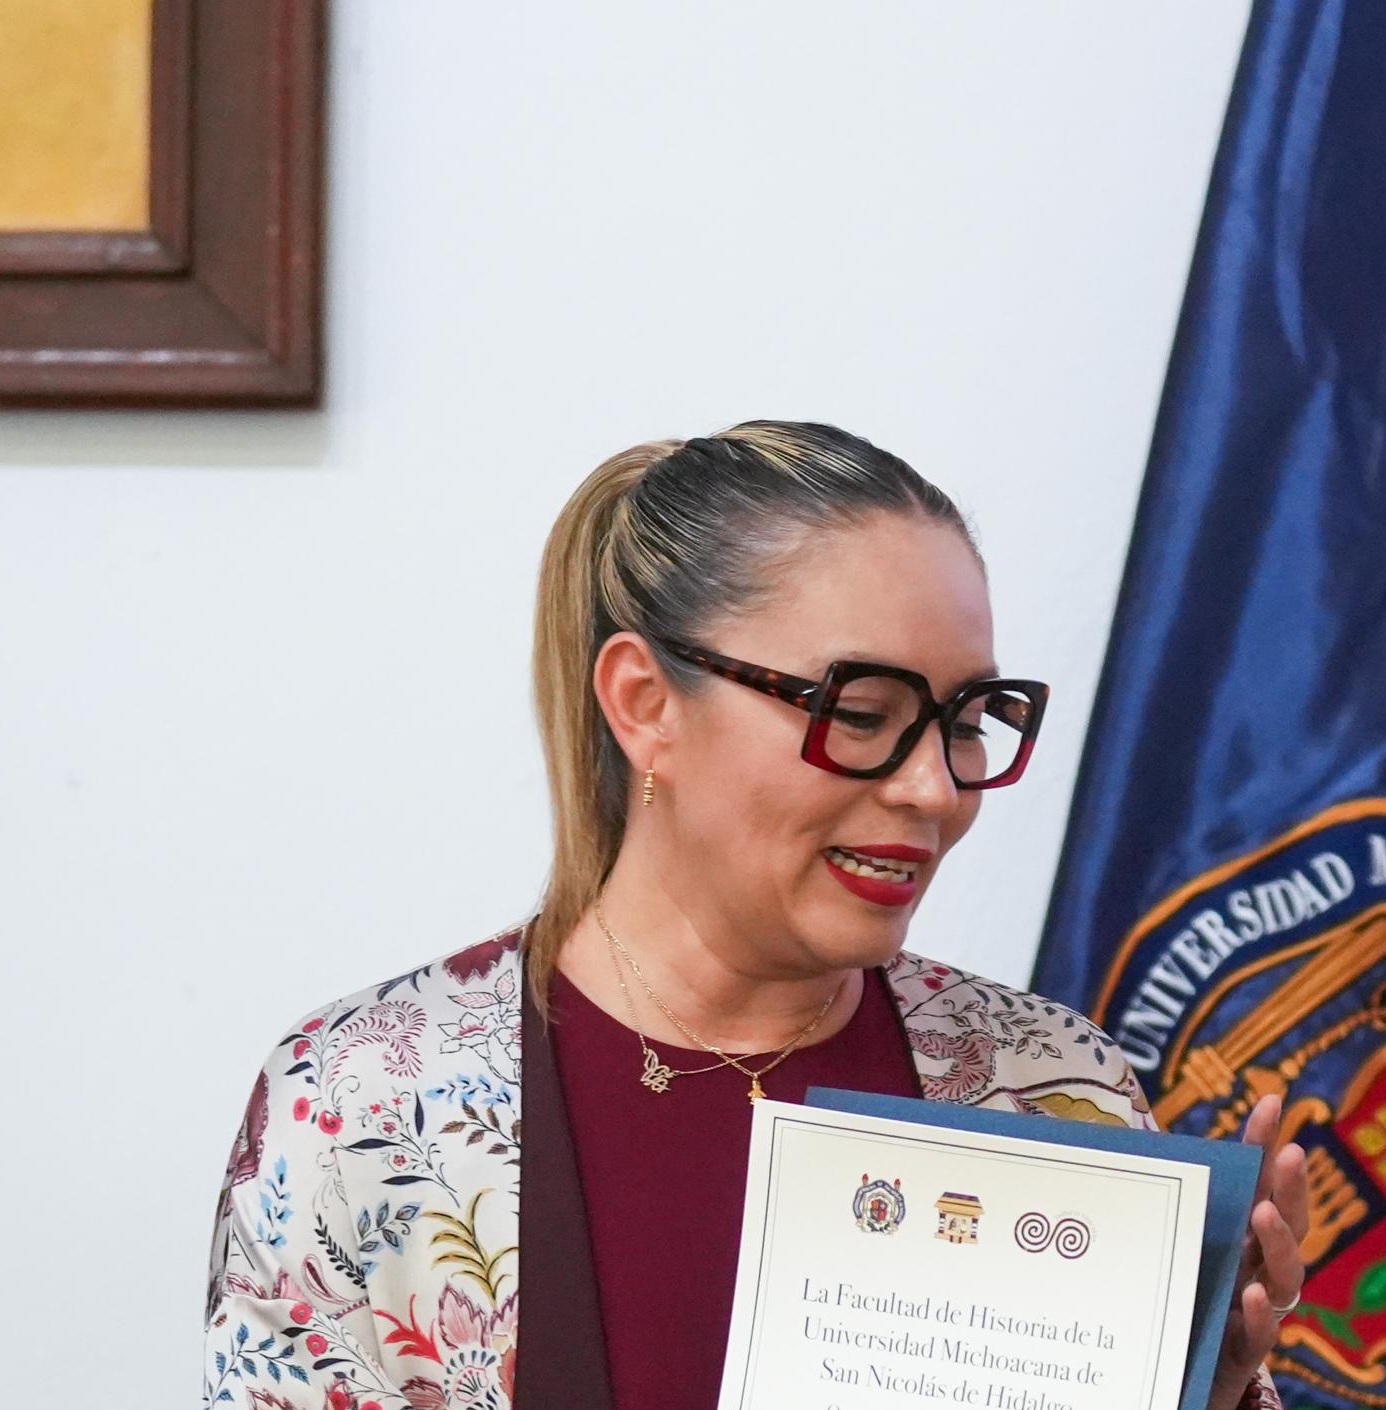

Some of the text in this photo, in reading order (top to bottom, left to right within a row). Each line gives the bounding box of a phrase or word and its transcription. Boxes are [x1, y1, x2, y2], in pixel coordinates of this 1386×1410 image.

[1116, 852, 1355, 1072] UNIVERSIDAD
[802, 1278, 1116, 1350] La Facultad de Historia de la
[803, 1316, 1104, 1386] Universidad Michoacana de
[820, 1357, 860, 1386] San
[867, 1364, 947, 1399] Nicolás
[952, 1379, 979, 1404] de
